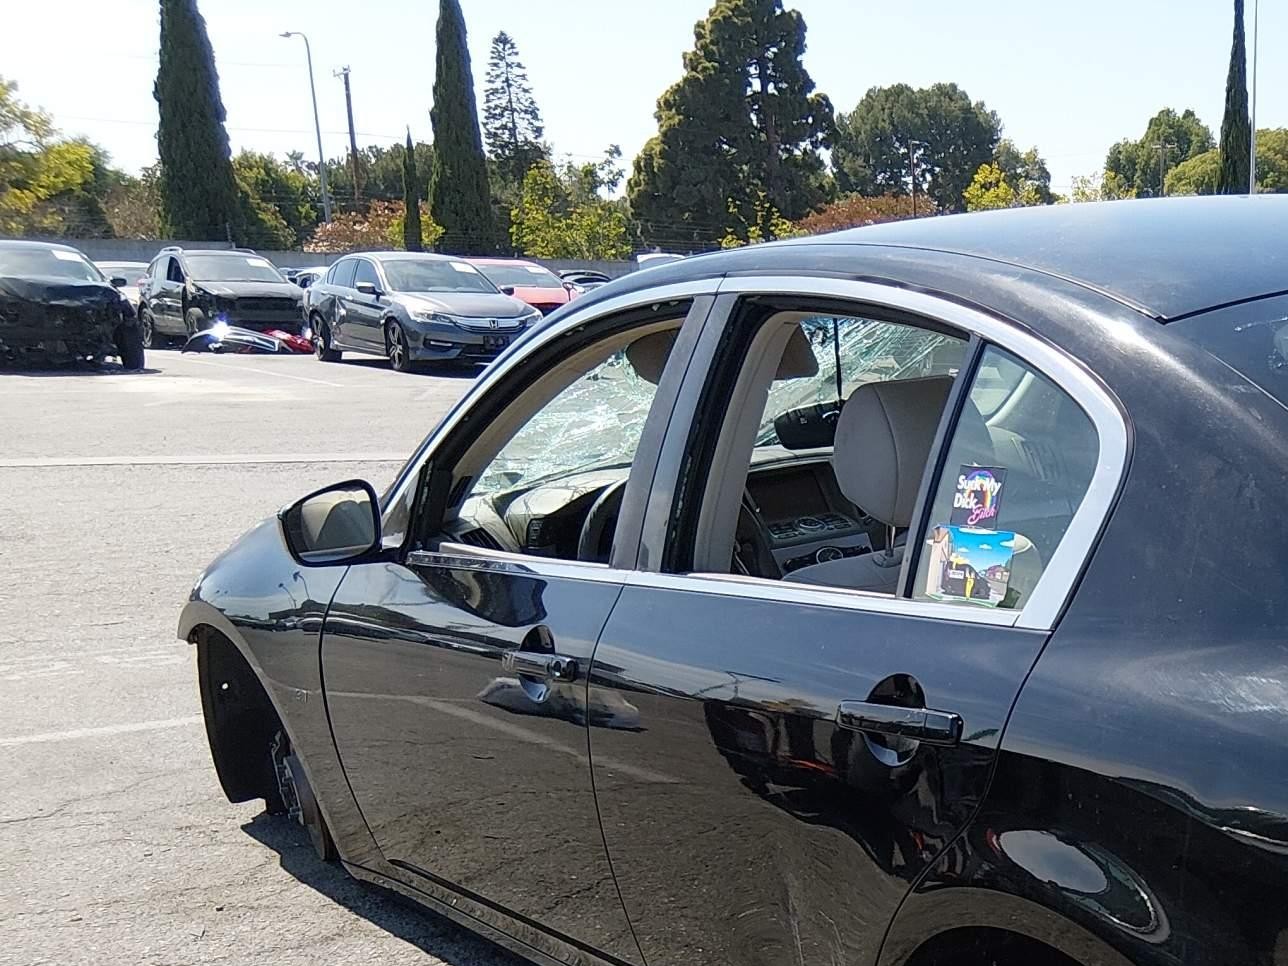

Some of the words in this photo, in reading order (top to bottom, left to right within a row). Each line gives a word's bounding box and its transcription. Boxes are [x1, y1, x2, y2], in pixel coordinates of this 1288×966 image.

[957, 474, 982, 491] Suck
[982, 477, 1002, 497] My
[953, 492, 978, 509] Dick
